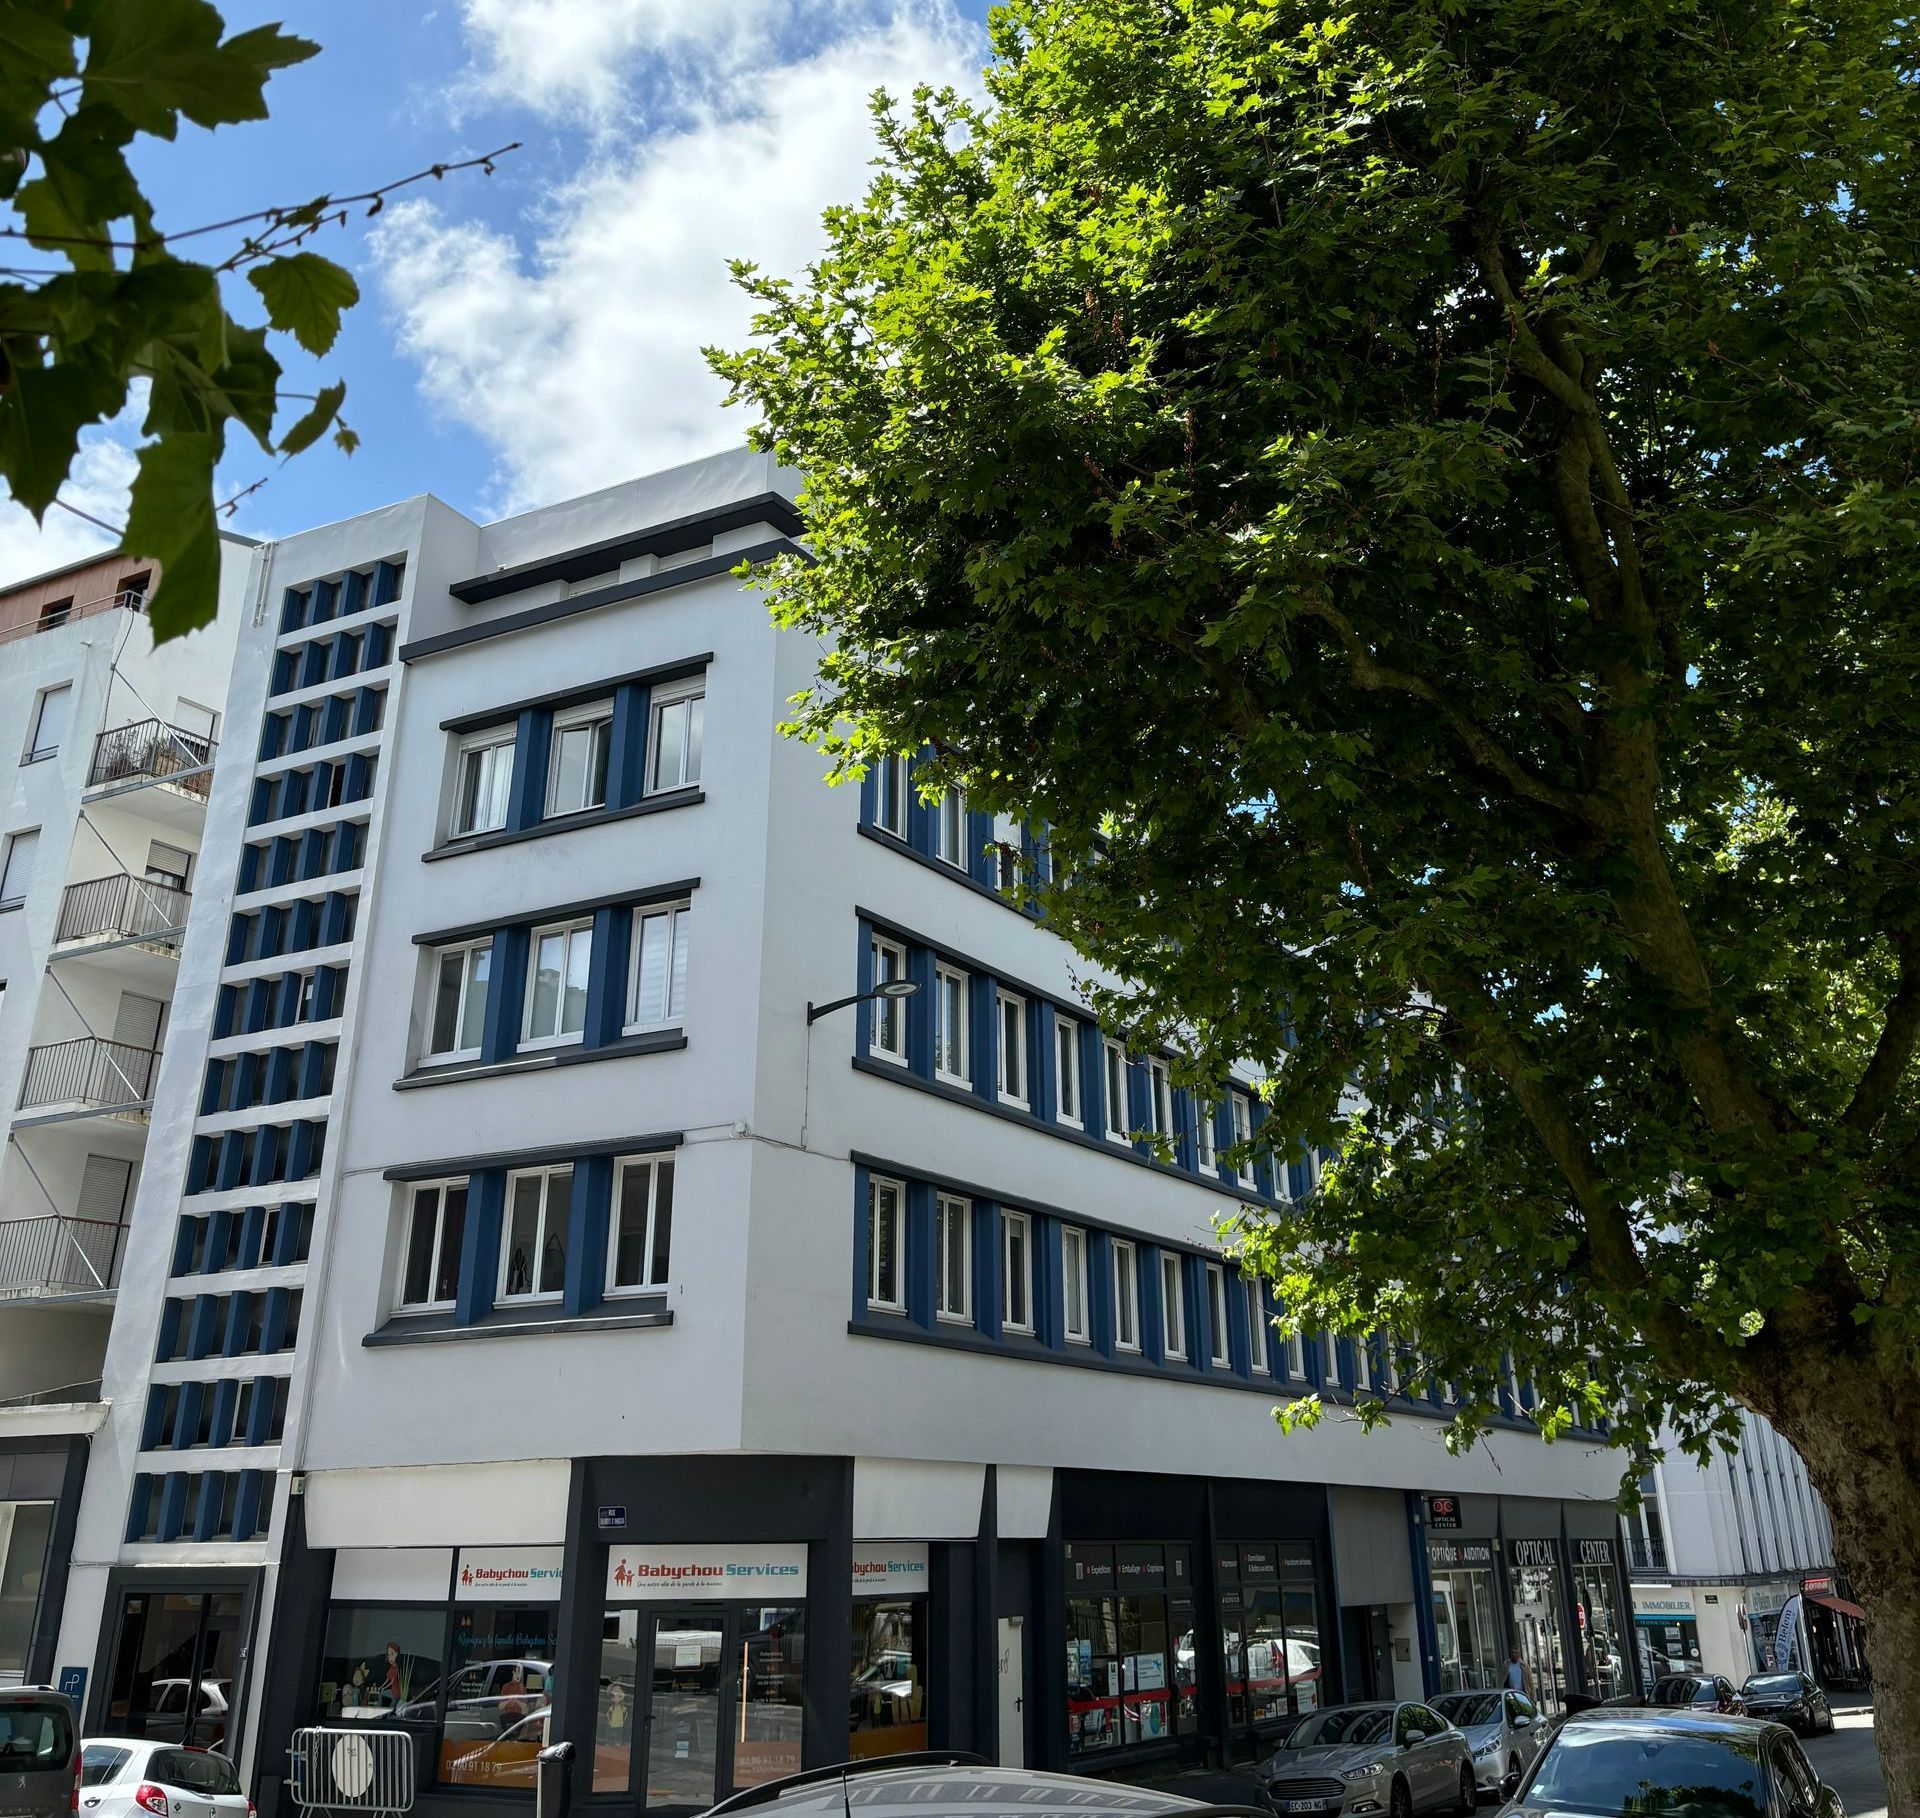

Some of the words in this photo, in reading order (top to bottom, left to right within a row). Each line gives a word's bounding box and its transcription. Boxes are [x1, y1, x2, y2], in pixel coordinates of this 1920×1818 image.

[1431, 1546, 1457, 1561] OPTIQUE
[1464, 1546, 1490, 1561] AUDITION
[1515, 1540, 1555, 1565] OPTICAL
[1580, 1540, 1610, 1563] CENTER
[475, 1568, 529, 1581] Babychou
[638, 1564, 723, 1579] Babychou
[726, 1563, 799, 1576] Services
[852, 1561, 886, 1575] bychou
[888, 1560, 925, 1572] Services
[1642, 1601, 1691, 1610] IMMOBILIER
[1779, 1609, 1793, 1643] Belem
[468, 1761, 478, 1771] 91
[480, 1761, 490, 1772] 18
